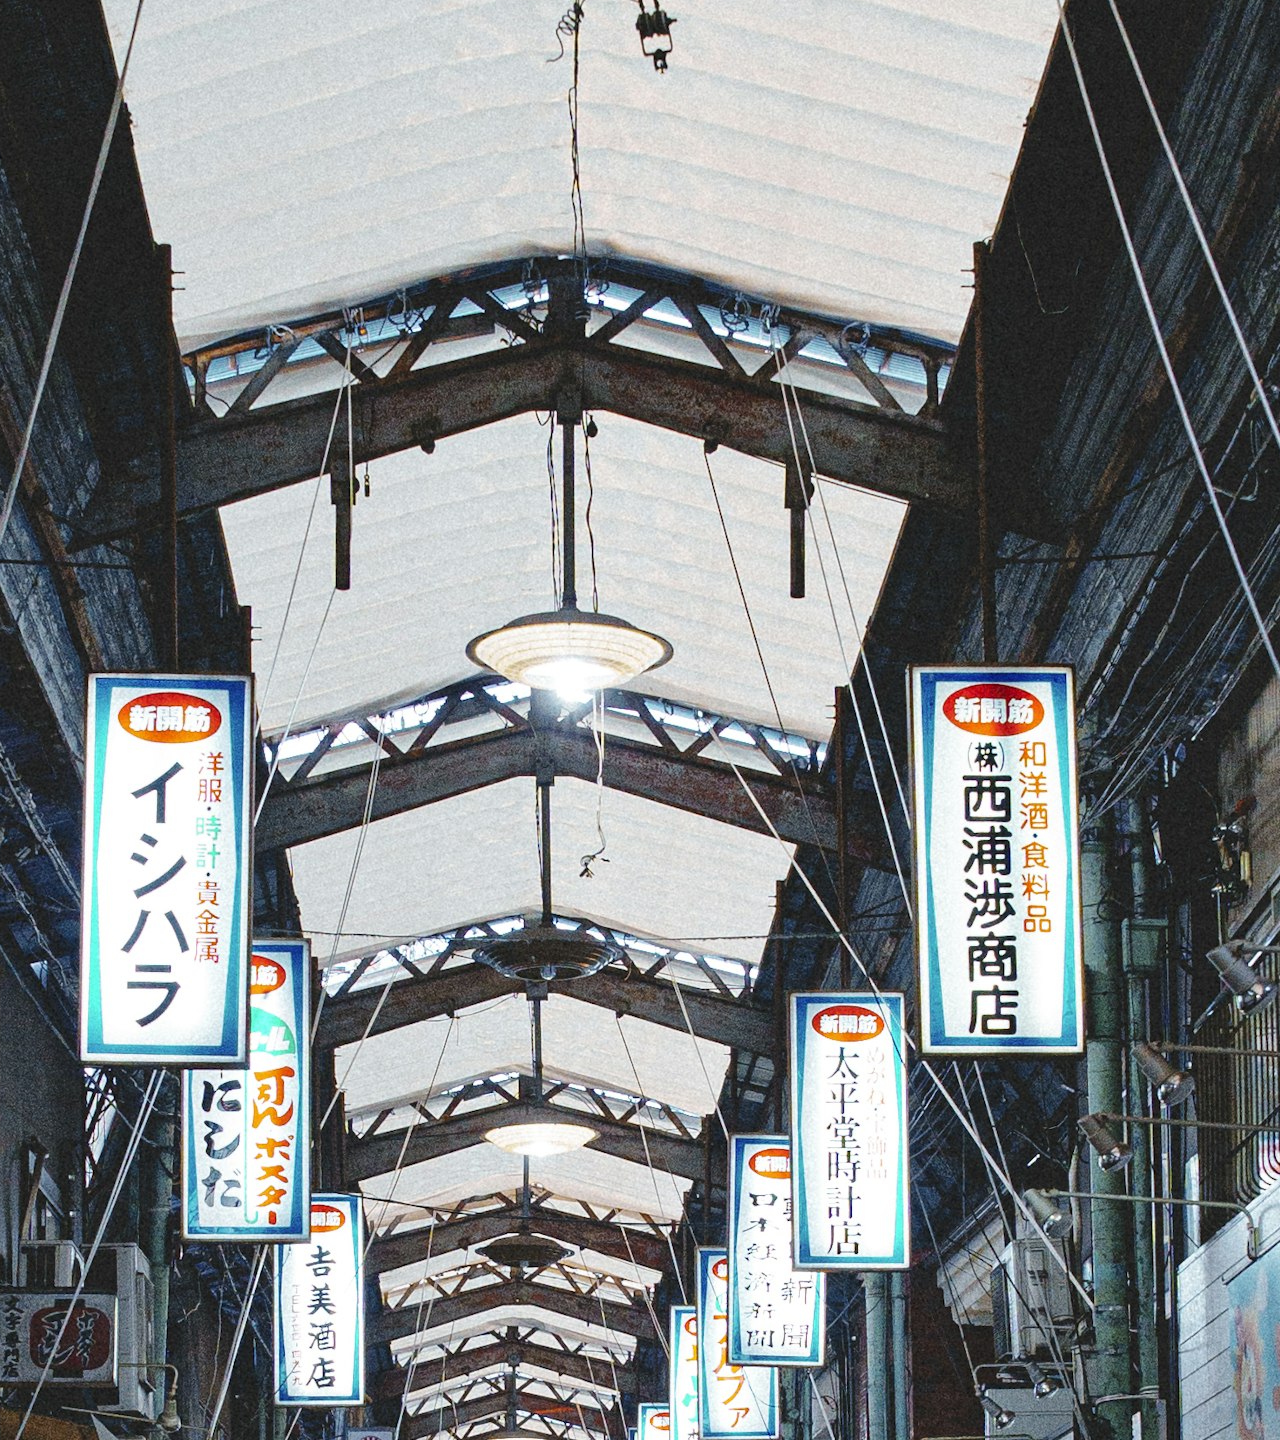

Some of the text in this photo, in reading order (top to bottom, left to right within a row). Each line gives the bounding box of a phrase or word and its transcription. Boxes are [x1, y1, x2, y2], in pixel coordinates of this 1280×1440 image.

[129, 705, 211, 733] 新開筋
[954, 696, 1034, 726] 新開筋
[121, 761, 190, 1028] イシハラ
[194, 751, 225, 964] 洋服・時計・貴金属
[1018, 740, 1051, 933] 和洋酒・食料品
[819, 1014, 878, 1034] 新開筋
[825, 1046, 862, 1256] 太平堂時計店
